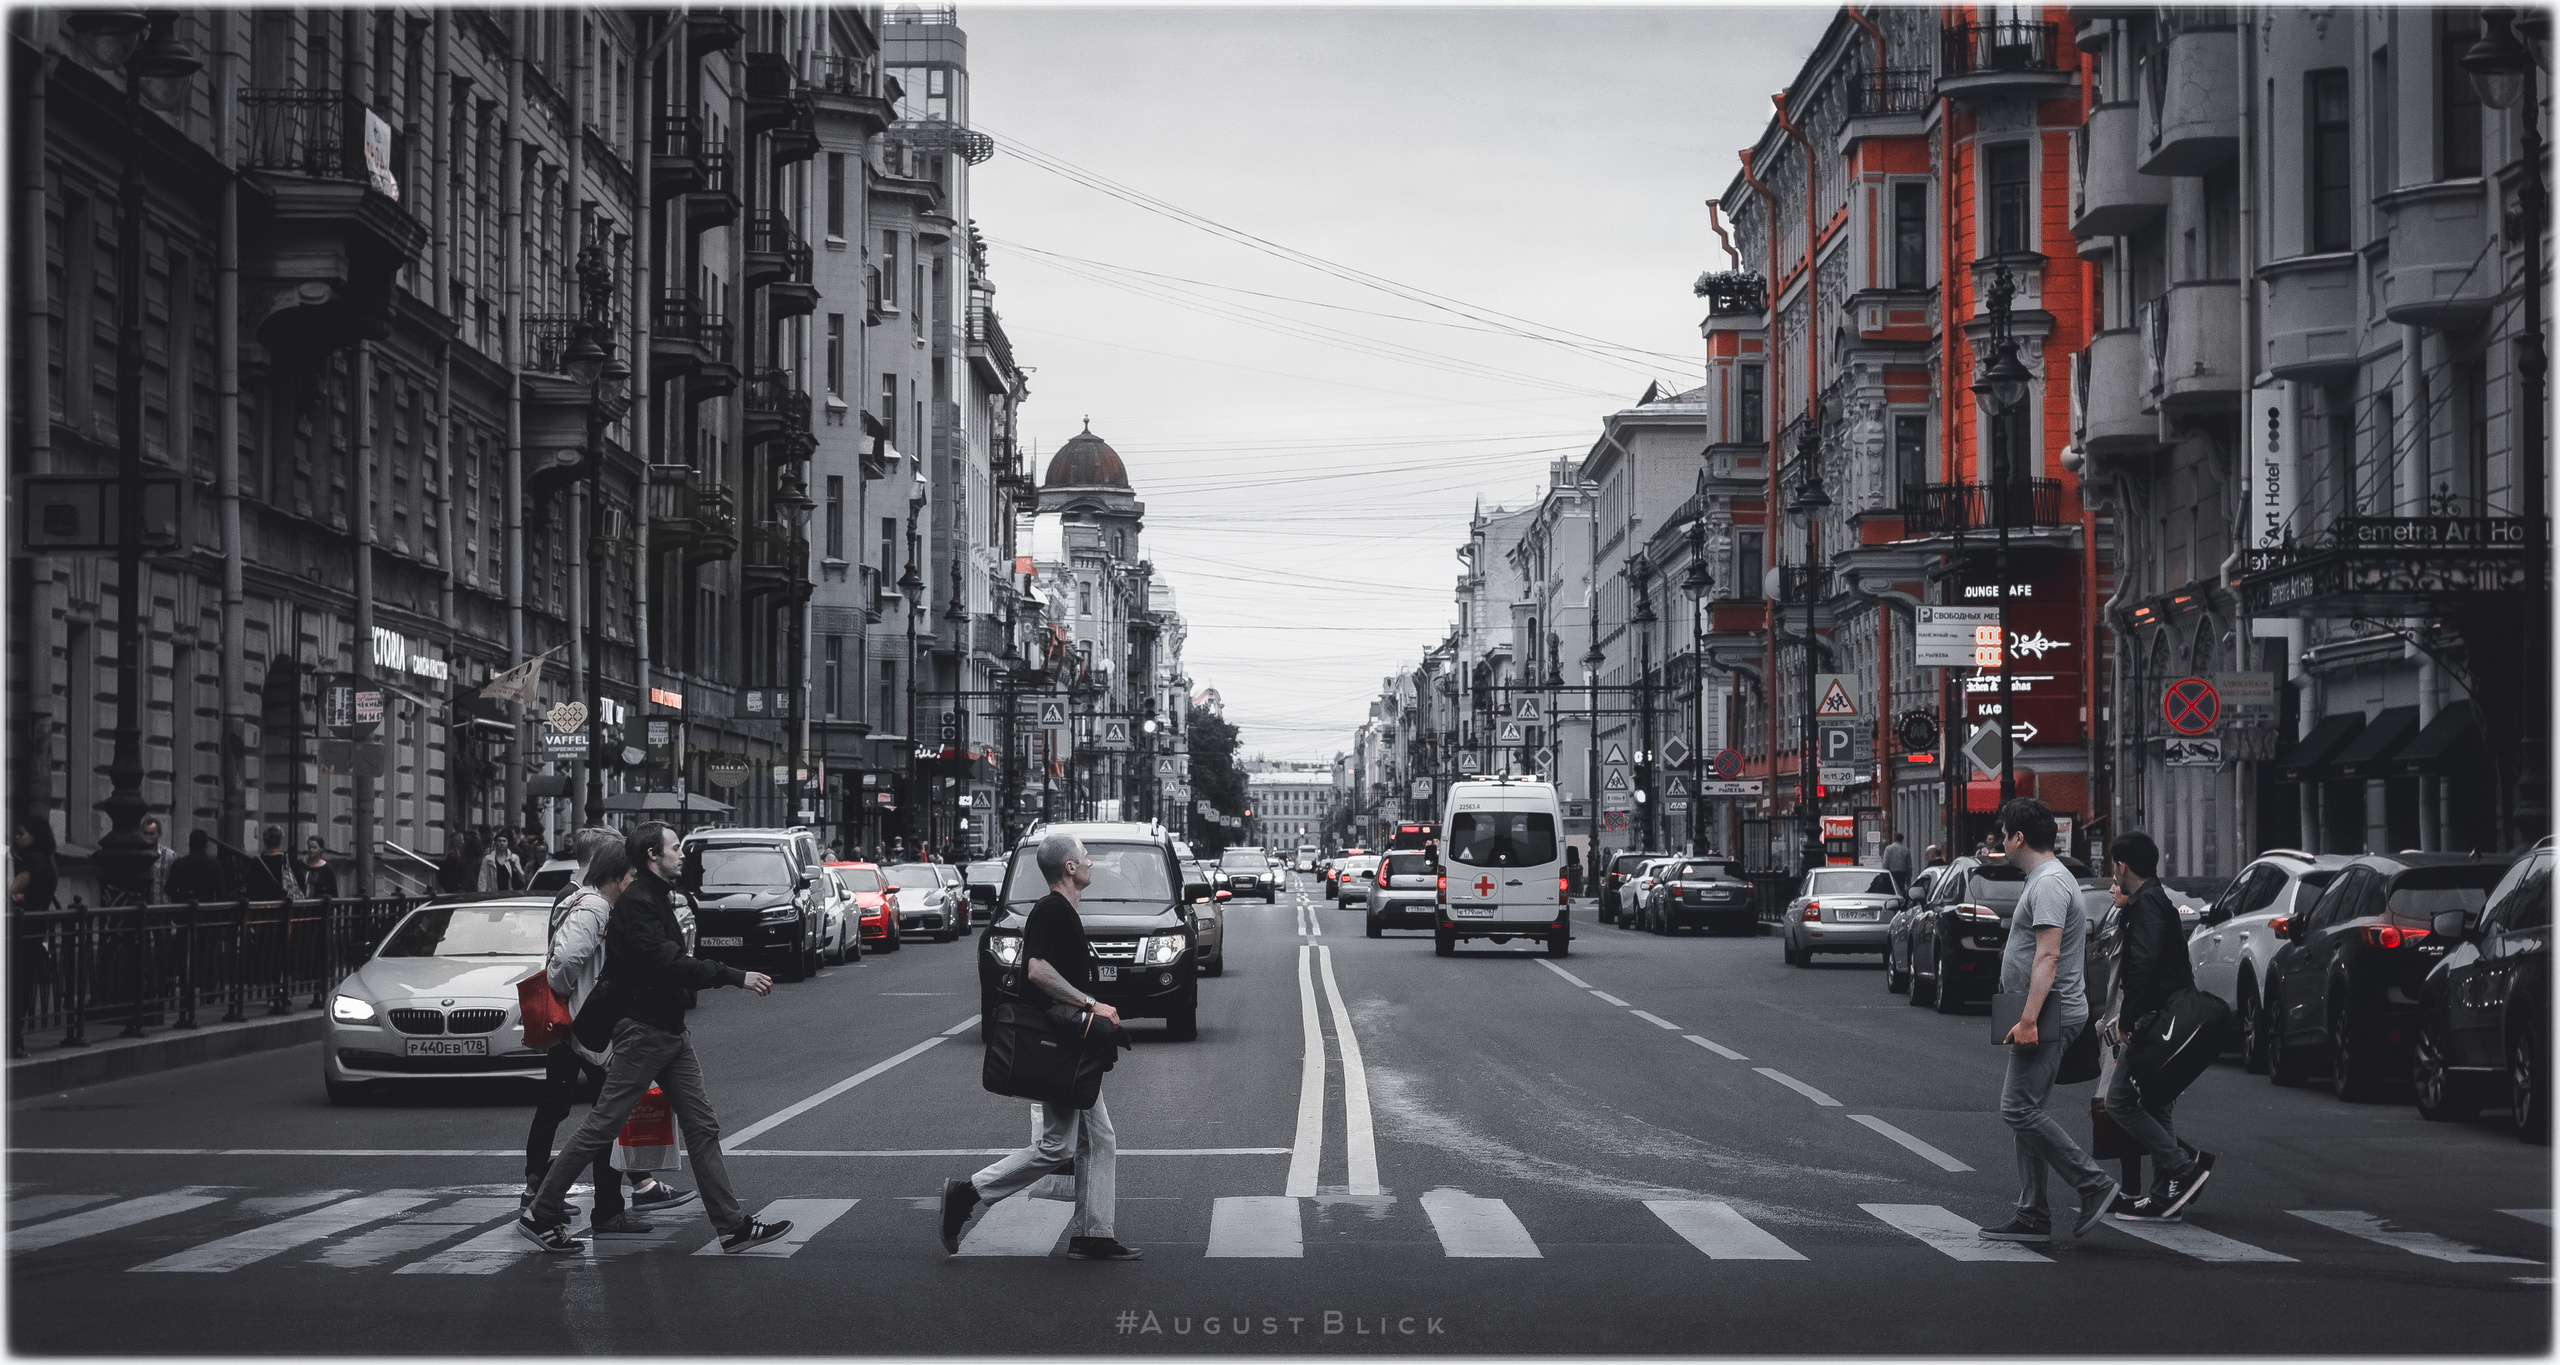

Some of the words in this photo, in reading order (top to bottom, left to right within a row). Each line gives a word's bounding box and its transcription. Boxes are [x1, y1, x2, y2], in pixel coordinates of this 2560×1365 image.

[2265, 463, 2280, 507] Hotel
[2265, 511, 2280, 540] Art
[2445, 521, 2481, 541] Art
[1964, 586, 1999, 597] OUNGE
[2009, 585, 2032, 596] AFE
[1934, 612, 1981, 620] СВОБОДНЫХ
[1984, 612, 2000, 620] МЕС
[1979, 704, 2002, 715] КАФ
[545, 735, 589, 745] VAFFEL
[1830, 731, 1848, 758] P
[1840, 772, 1851, 780] 20
[1101, 967, 1115, 975] 178
[411, 1042, 460, 1054] Р440ЕВ
[464, 1041, 482, 1051] 178
